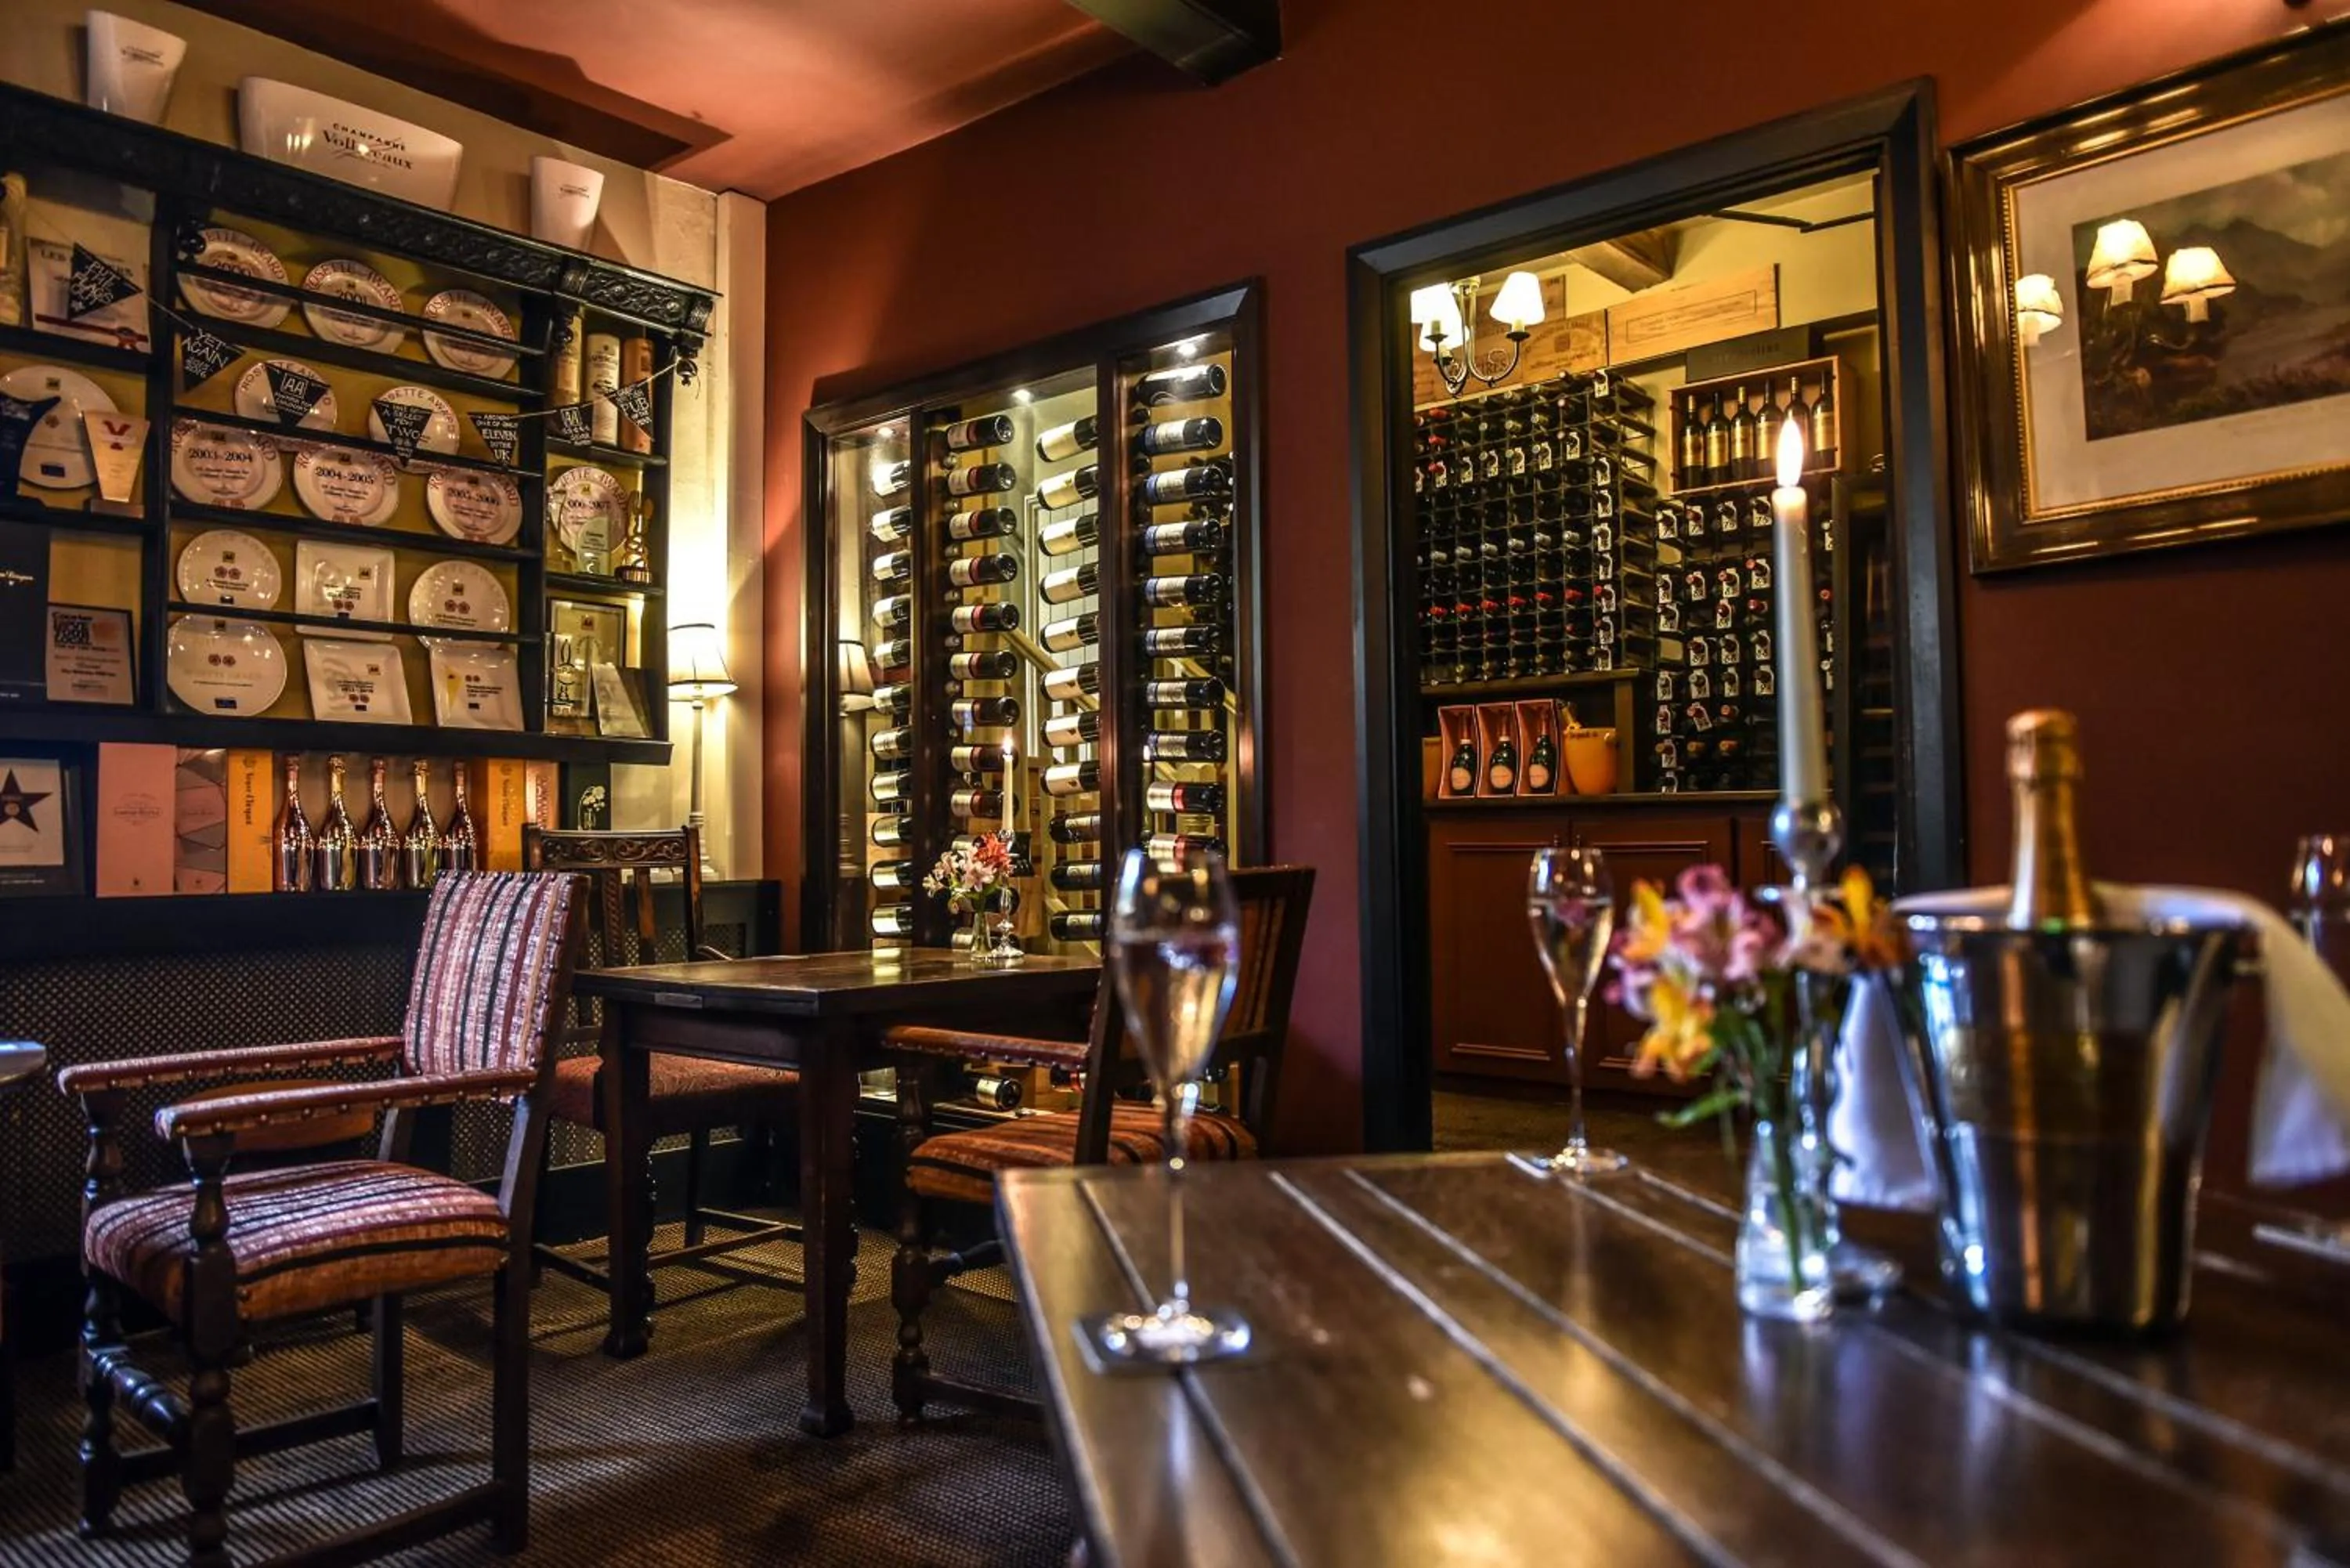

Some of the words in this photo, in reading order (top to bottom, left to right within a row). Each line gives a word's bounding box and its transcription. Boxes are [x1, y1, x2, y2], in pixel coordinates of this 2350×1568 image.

[333, 122, 406, 151] CHAMPAGNE
[196, 327, 226, 351] YET
[181, 337, 229, 370] AGAIN
[284, 378, 305, 396] AA
[620, 396, 649, 415] PUB
[385, 423, 421, 440] TWO
[482, 428, 517, 441] ELEVEN
[494, 449, 511, 461] UK
